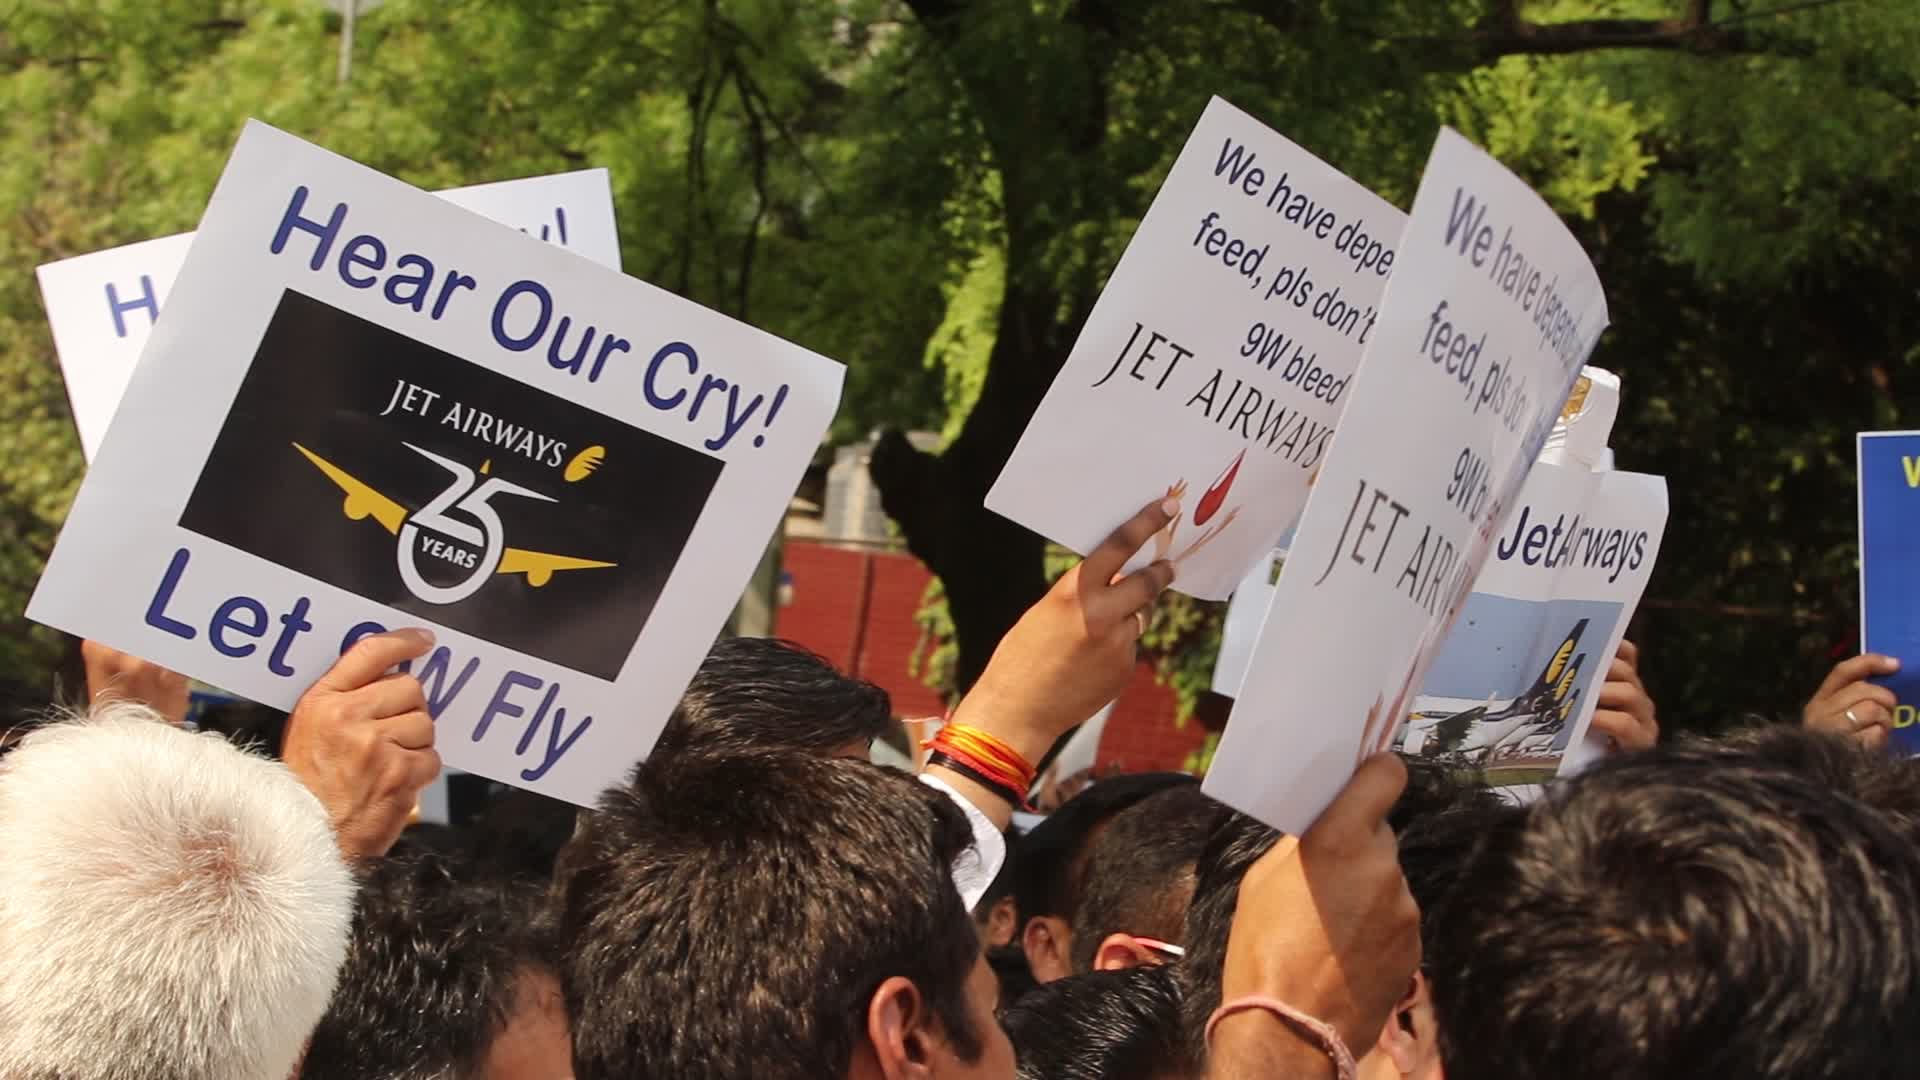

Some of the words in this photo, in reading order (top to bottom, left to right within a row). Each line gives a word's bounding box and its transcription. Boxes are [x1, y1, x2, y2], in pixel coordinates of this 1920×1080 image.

[1214, 138, 1265, 197] We
[1266, 173, 1336, 240] have
[1335, 219, 1396, 280] depe
[1445, 187, 1494, 268] We
[1489, 225, 1542, 312] have
[270, 186, 476, 321] Hear
[490, 280, 631, 384] Our
[643, 341, 790, 451] Cry!
[1193, 212, 1270, 289] feed,
[1264, 267, 1314, 308] pls
[1312, 287, 1378, 344] don't
[1091, 322, 1194, 391] JET
[1185, 369, 1335, 469] AIRWAYS
[1240, 322, 1293, 371] 9W
[1281, 346, 1353, 406] bleed
[1420, 300, 1487, 401] feed,
[380, 379, 441, 417] JET
[440, 402, 568, 468] AIRWAYS
[397, 441, 561, 605] 25
[421, 536, 478, 570] YEARS
[1314, 479, 1410, 587] JET
[145, 547, 311, 677] Let
[471, 670, 593, 781] Fly
